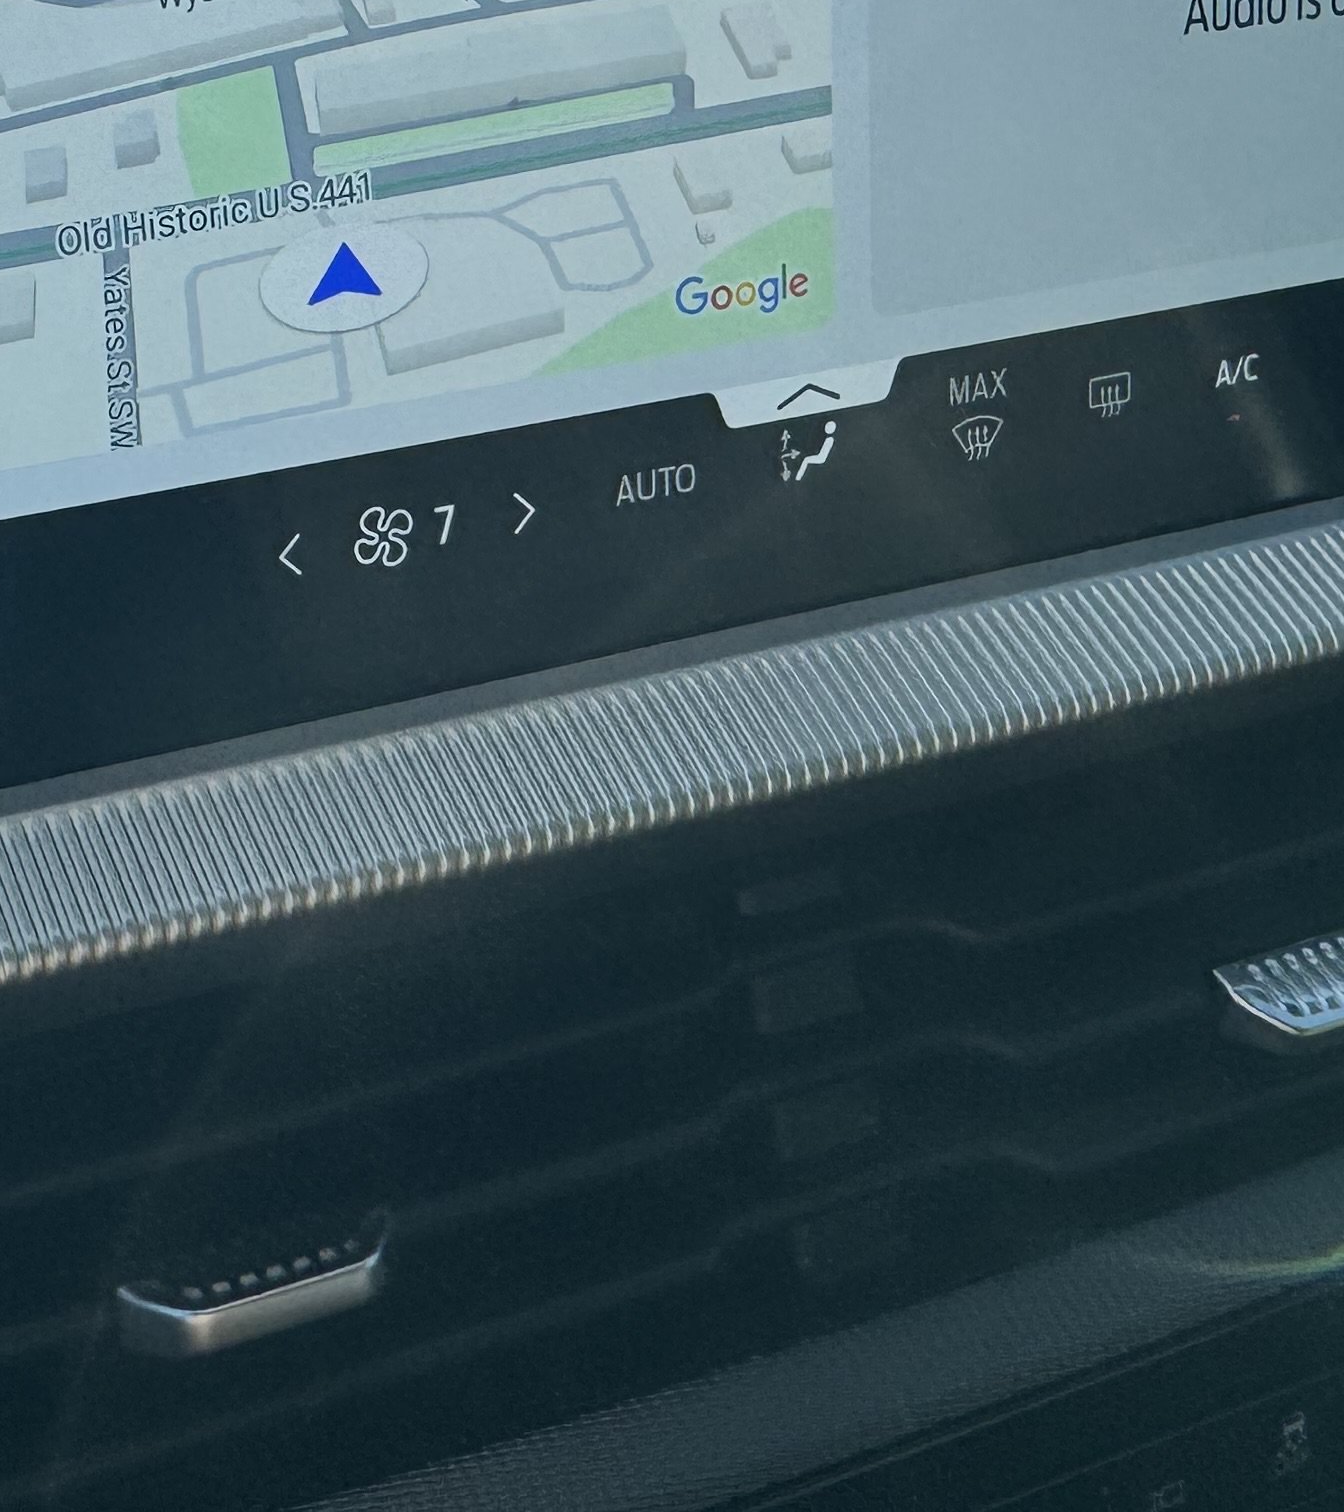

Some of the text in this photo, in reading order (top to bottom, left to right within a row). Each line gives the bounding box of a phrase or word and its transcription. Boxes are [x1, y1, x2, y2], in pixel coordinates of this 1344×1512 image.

[58, 218, 111, 256] Old
[122, 195, 248, 245] Historic
[675, 262, 809, 316] Google
[104, 265, 139, 450] Yates St SW
[1215, 353, 1260, 388] A/C
[948, 367, 1008, 407] MAX
[615, 463, 697, 507] AUTO
[433, 503, 456, 545] 7
